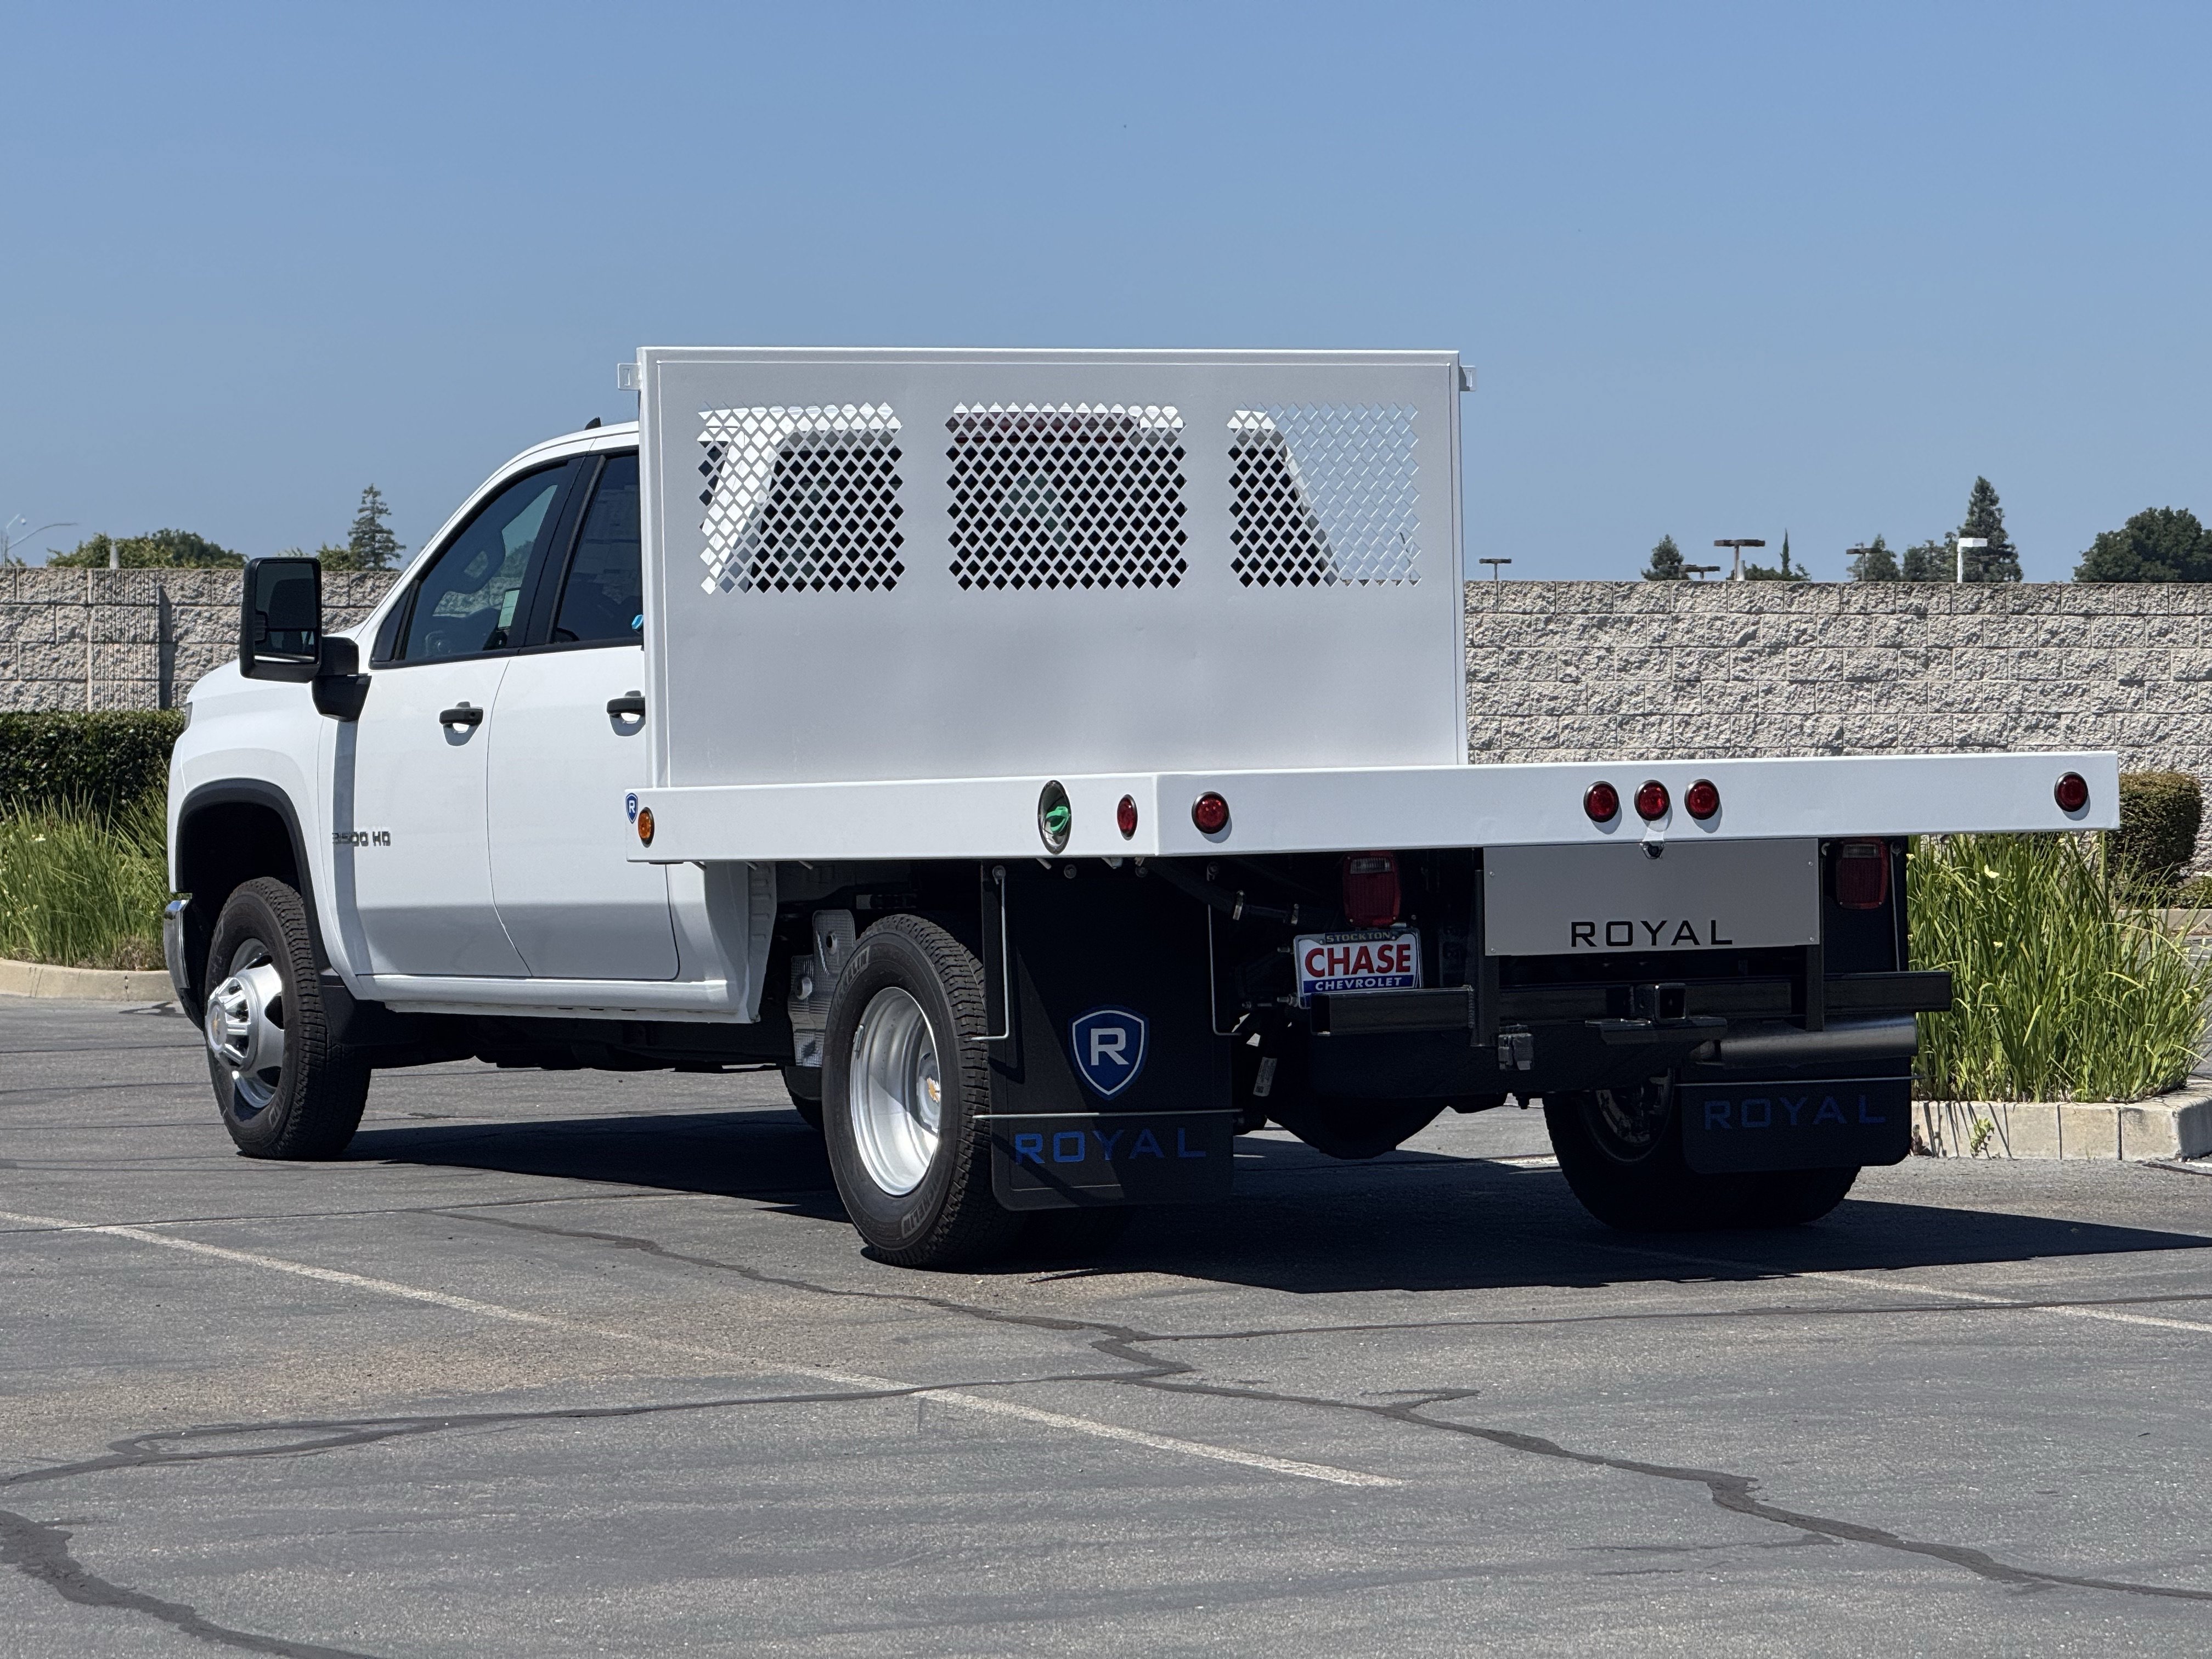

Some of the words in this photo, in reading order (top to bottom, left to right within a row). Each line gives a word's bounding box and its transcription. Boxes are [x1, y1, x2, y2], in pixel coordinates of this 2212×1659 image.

[629, 799, 636, 814] R
[373, 831, 391, 847] HD
[1326, 932, 1390, 943] STOCKTON
[1571, 919, 1733, 947] ROYAL
[1305, 944, 1411, 978] CHASE
[1315, 977, 1403, 991] CHEVROLET
[1091, 1028, 1130, 1066] R
[1705, 1095, 1886, 1130] ROYAL
[1014, 1127, 1206, 1165] ROYAL
